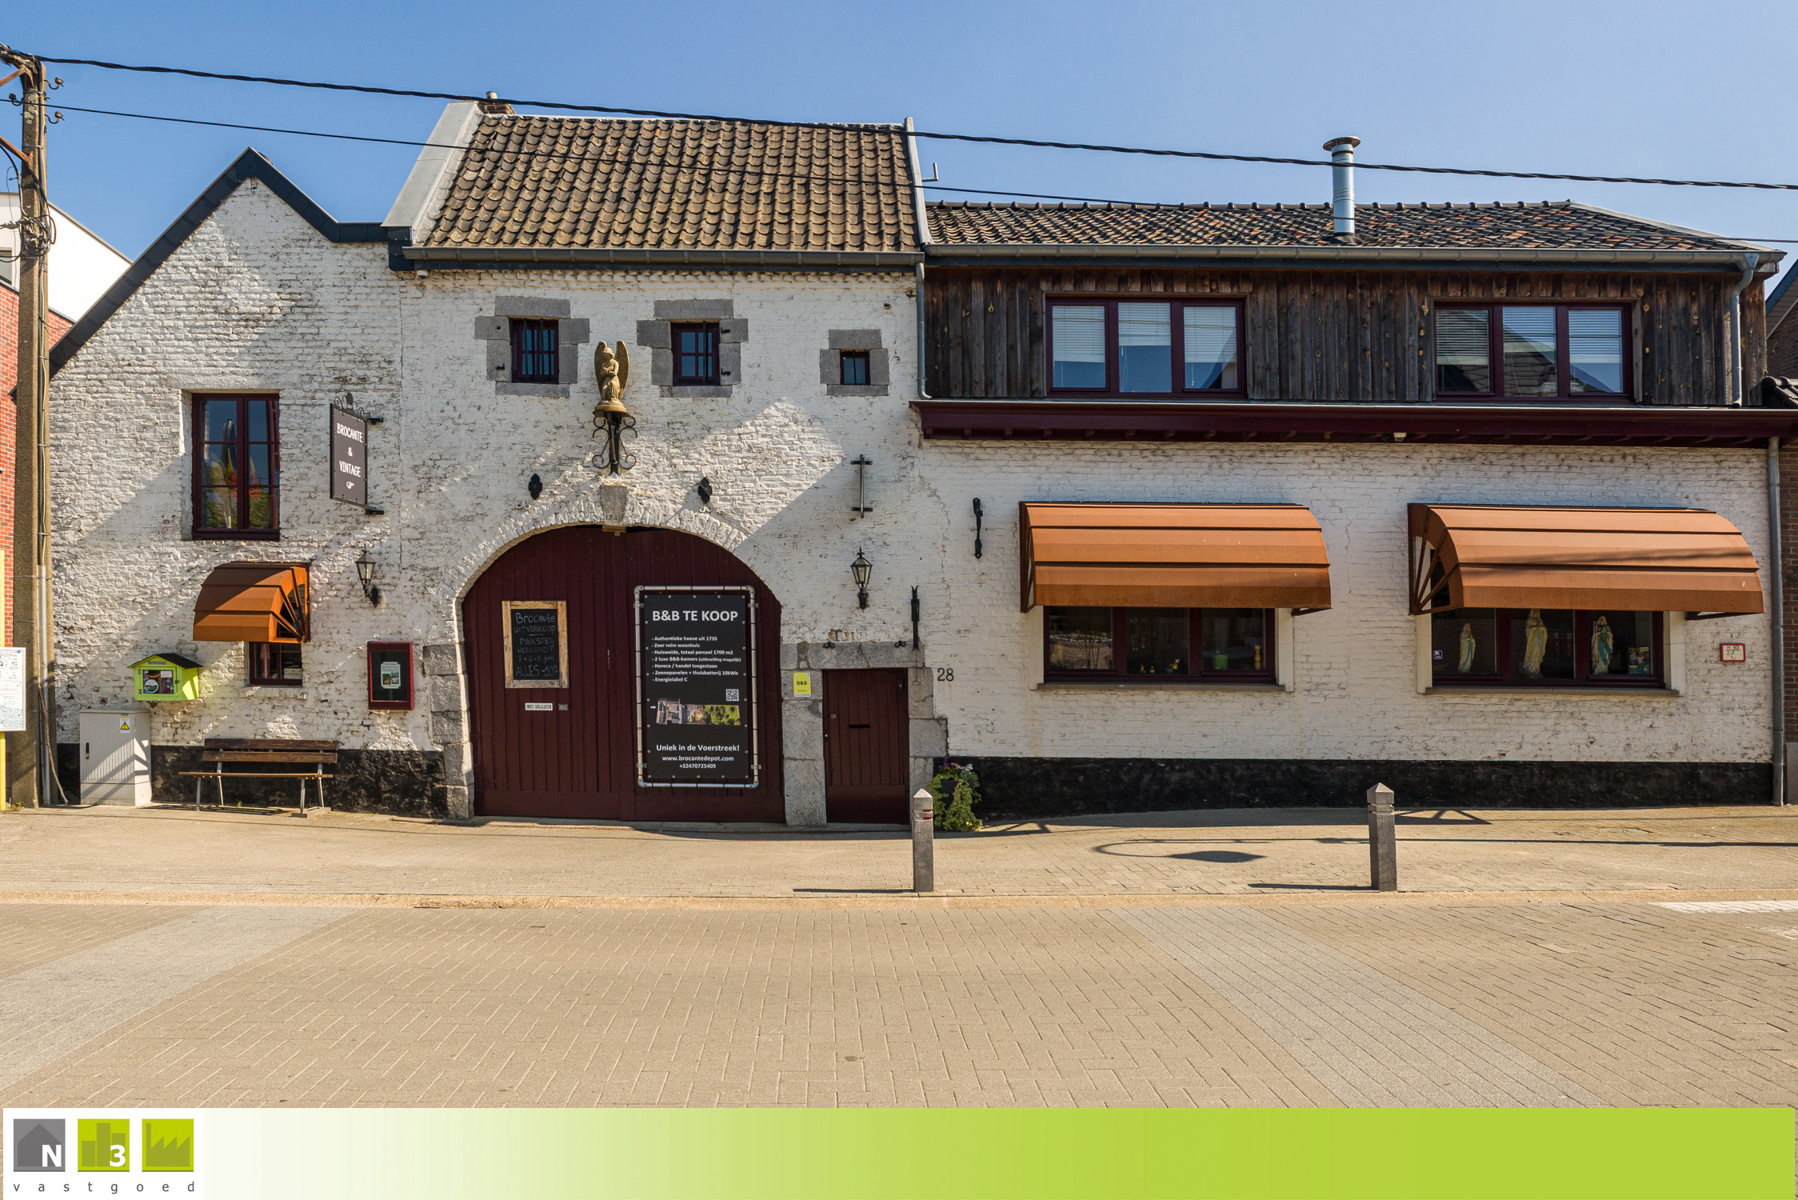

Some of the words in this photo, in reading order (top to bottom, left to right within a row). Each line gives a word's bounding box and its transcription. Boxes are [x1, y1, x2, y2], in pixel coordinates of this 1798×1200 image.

[336, 422, 363, 443] BROCANTE
[347, 446, 353, 457] &
[338, 460, 362, 478] VINTAGE
[652, 610, 680, 621] B&B
[683, 610, 698, 621] TE
[702, 610, 738, 621] KOOP
[937, 667, 954, 682] 28
